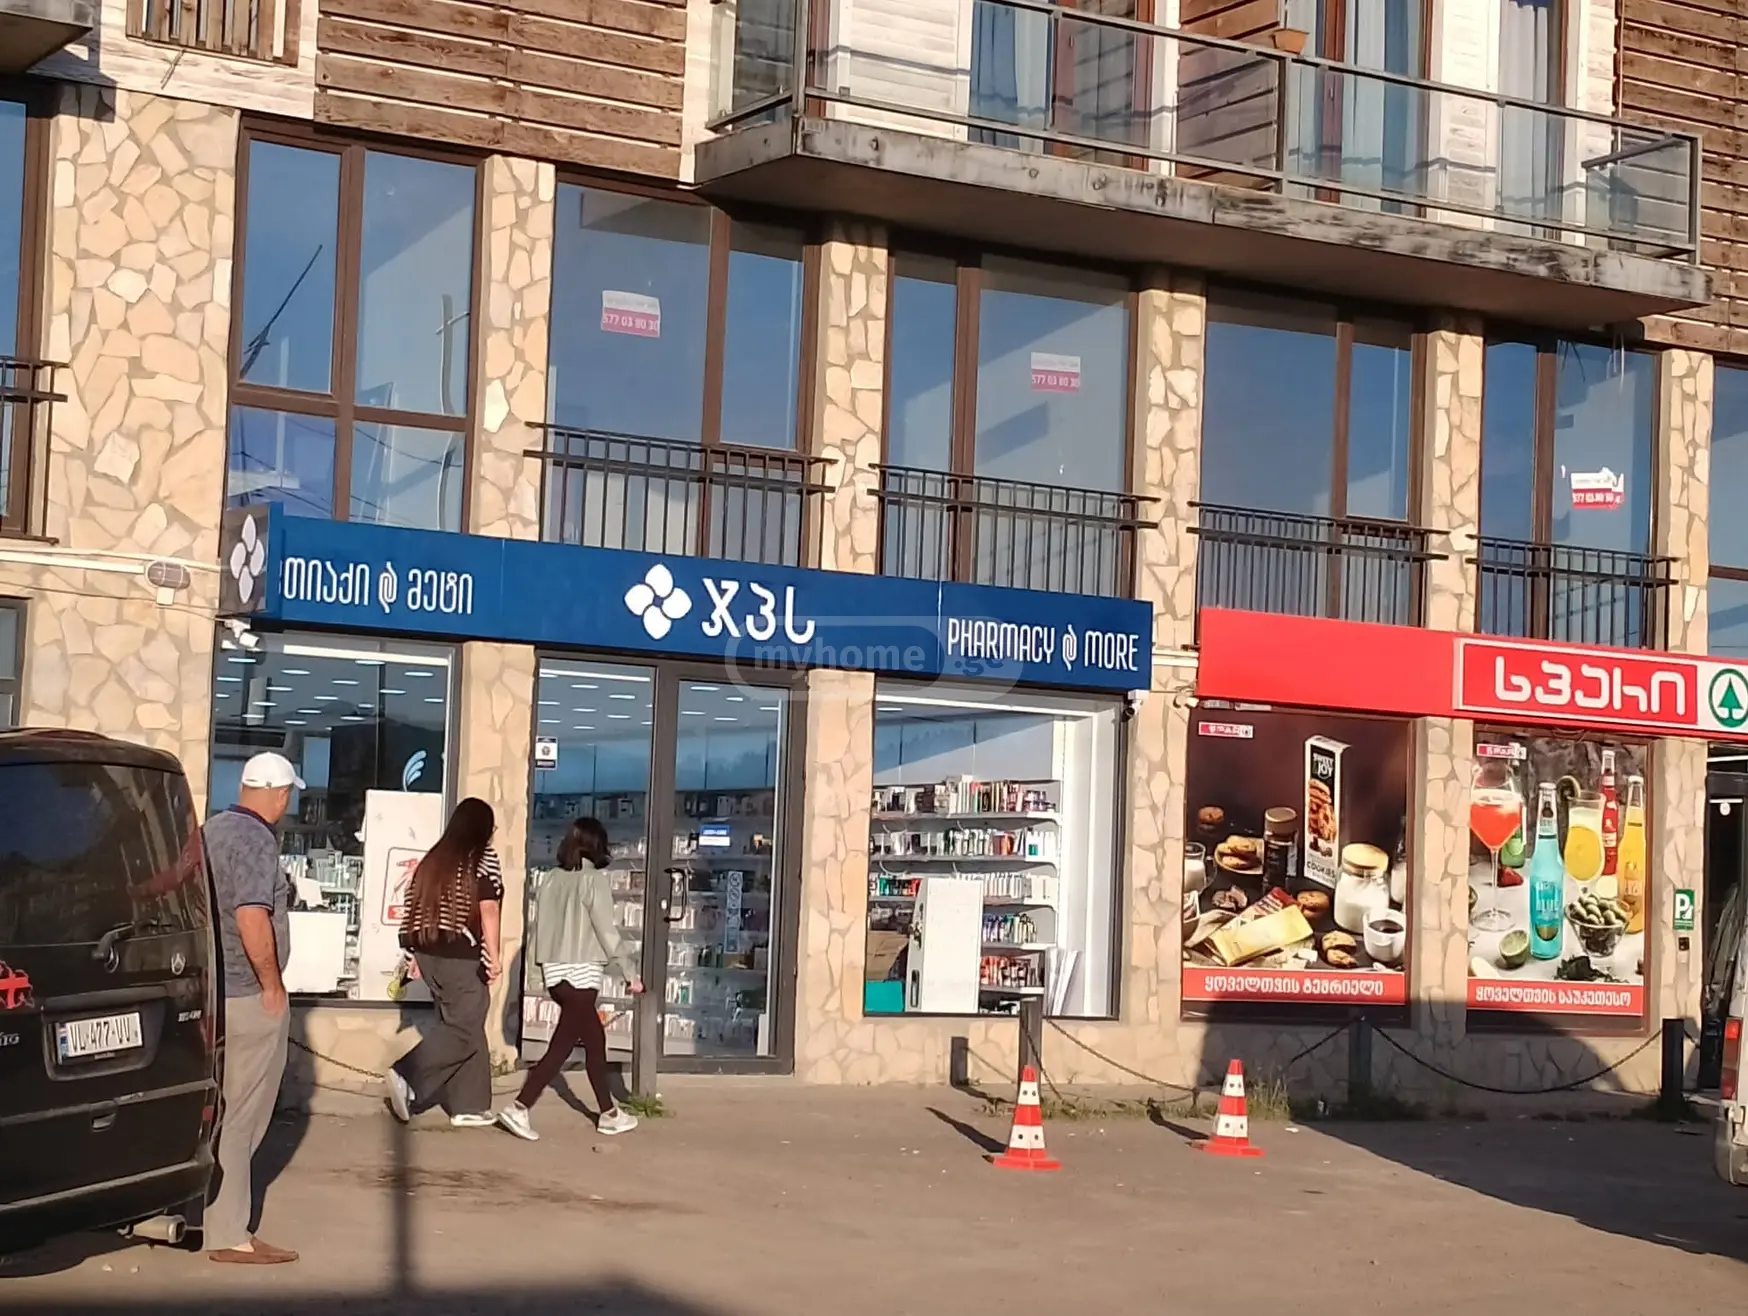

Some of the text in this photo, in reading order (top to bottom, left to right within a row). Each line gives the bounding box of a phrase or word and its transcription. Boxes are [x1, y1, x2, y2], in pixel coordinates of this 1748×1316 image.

[279, 556, 369, 606] თიაქი
[407, 568, 473, 615] მეტი
[947, 617, 1055, 665] PHARMACY
[1084, 630, 1139, 671] MORE
